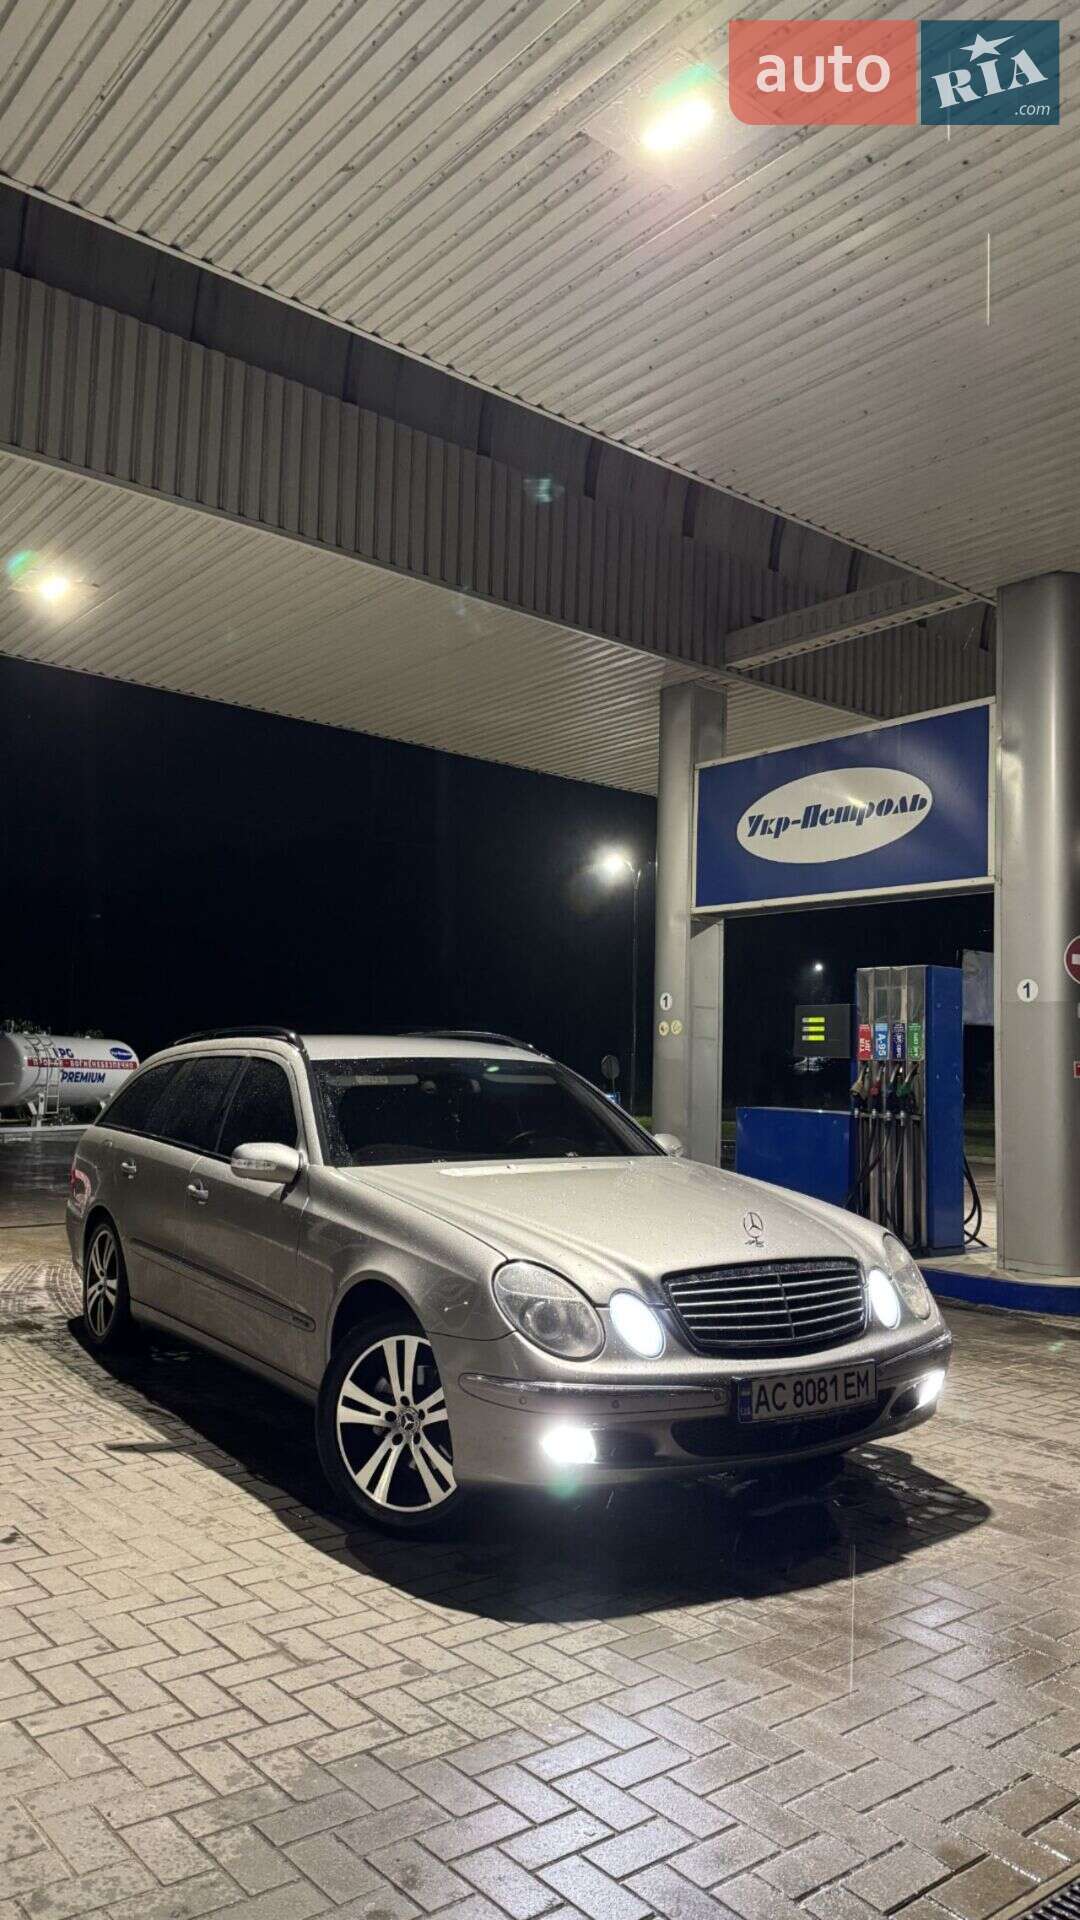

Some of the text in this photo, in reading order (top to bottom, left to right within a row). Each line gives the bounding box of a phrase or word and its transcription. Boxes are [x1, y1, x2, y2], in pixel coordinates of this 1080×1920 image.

[747, 794, 928, 839] Укр-Петроль
[1022, 982, 1030, 999] 1
[60, 1071, 106, 1084] PREMIUM
[754, 1370, 870, 1414] AC 8081 EM
